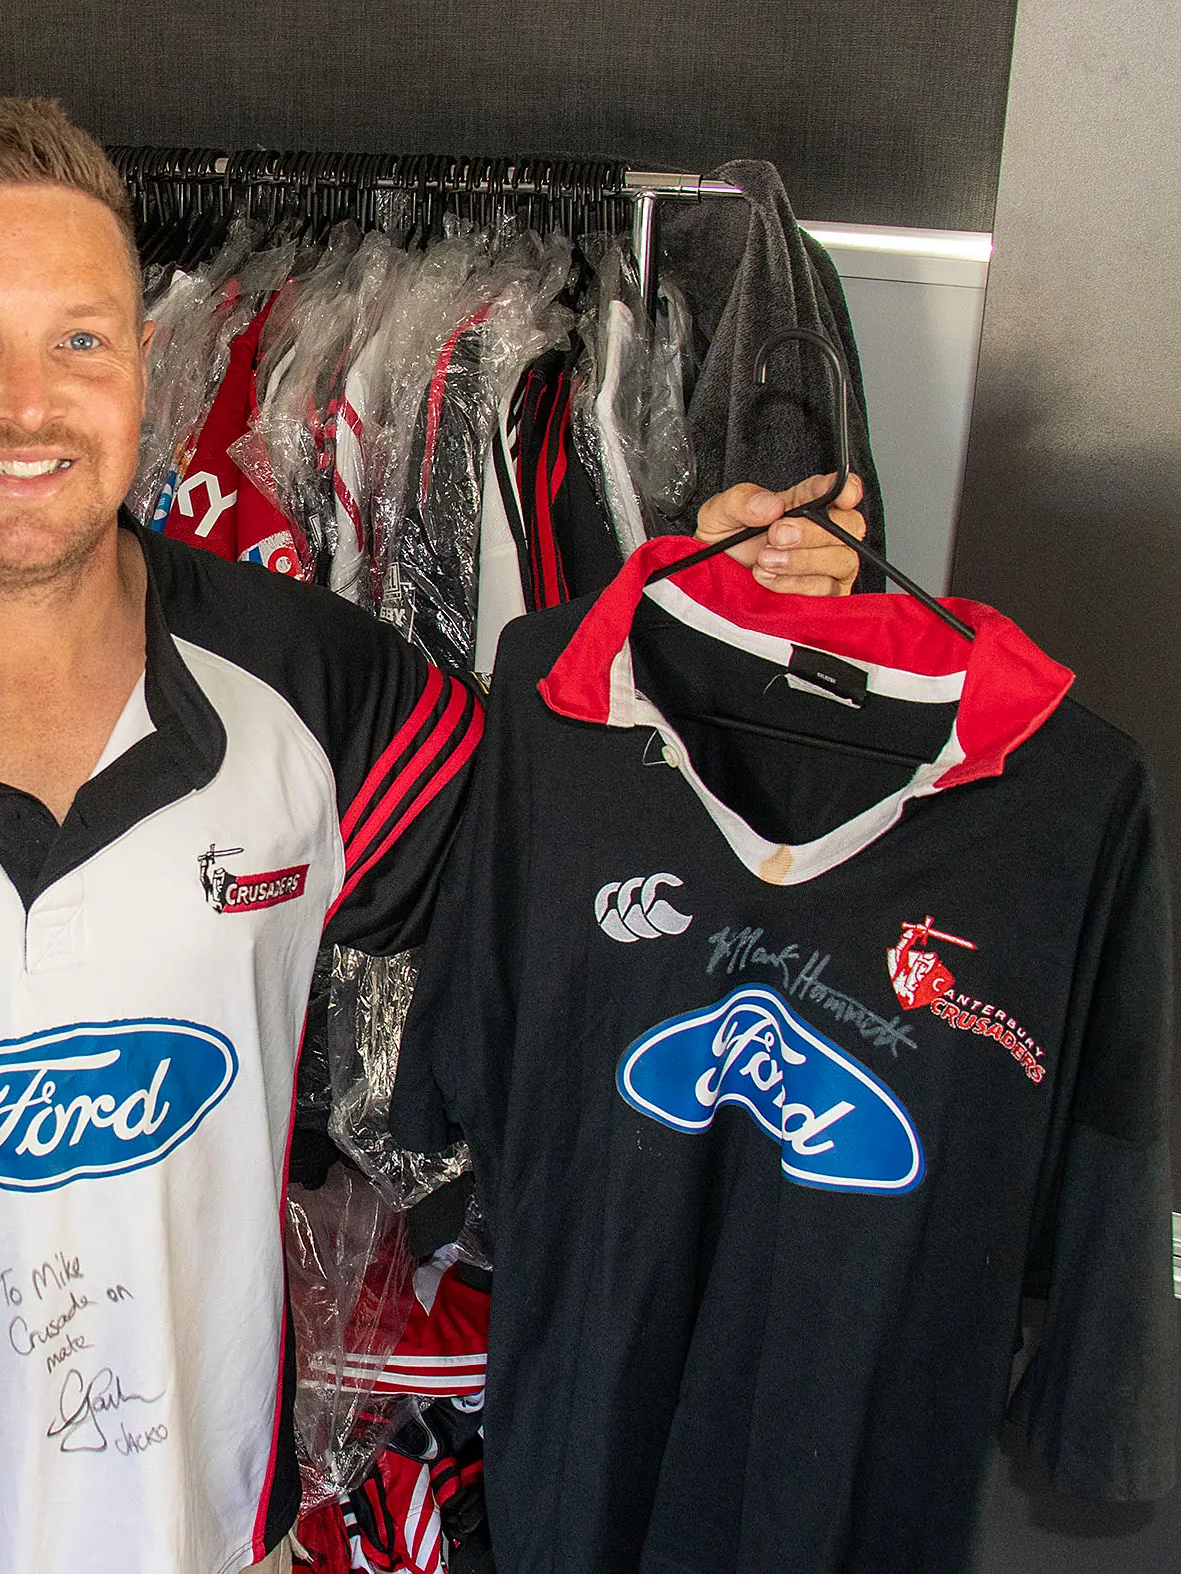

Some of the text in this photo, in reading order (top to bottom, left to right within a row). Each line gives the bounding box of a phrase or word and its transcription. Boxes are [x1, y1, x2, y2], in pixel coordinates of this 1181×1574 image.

[225, 873, 300, 906] CRUSADERS
[929, 997, 1046, 1084] CRUSADERS
[932, 977, 1045, 1057] CANTERBURY
[32, 1250, 84, 1300] Mike
